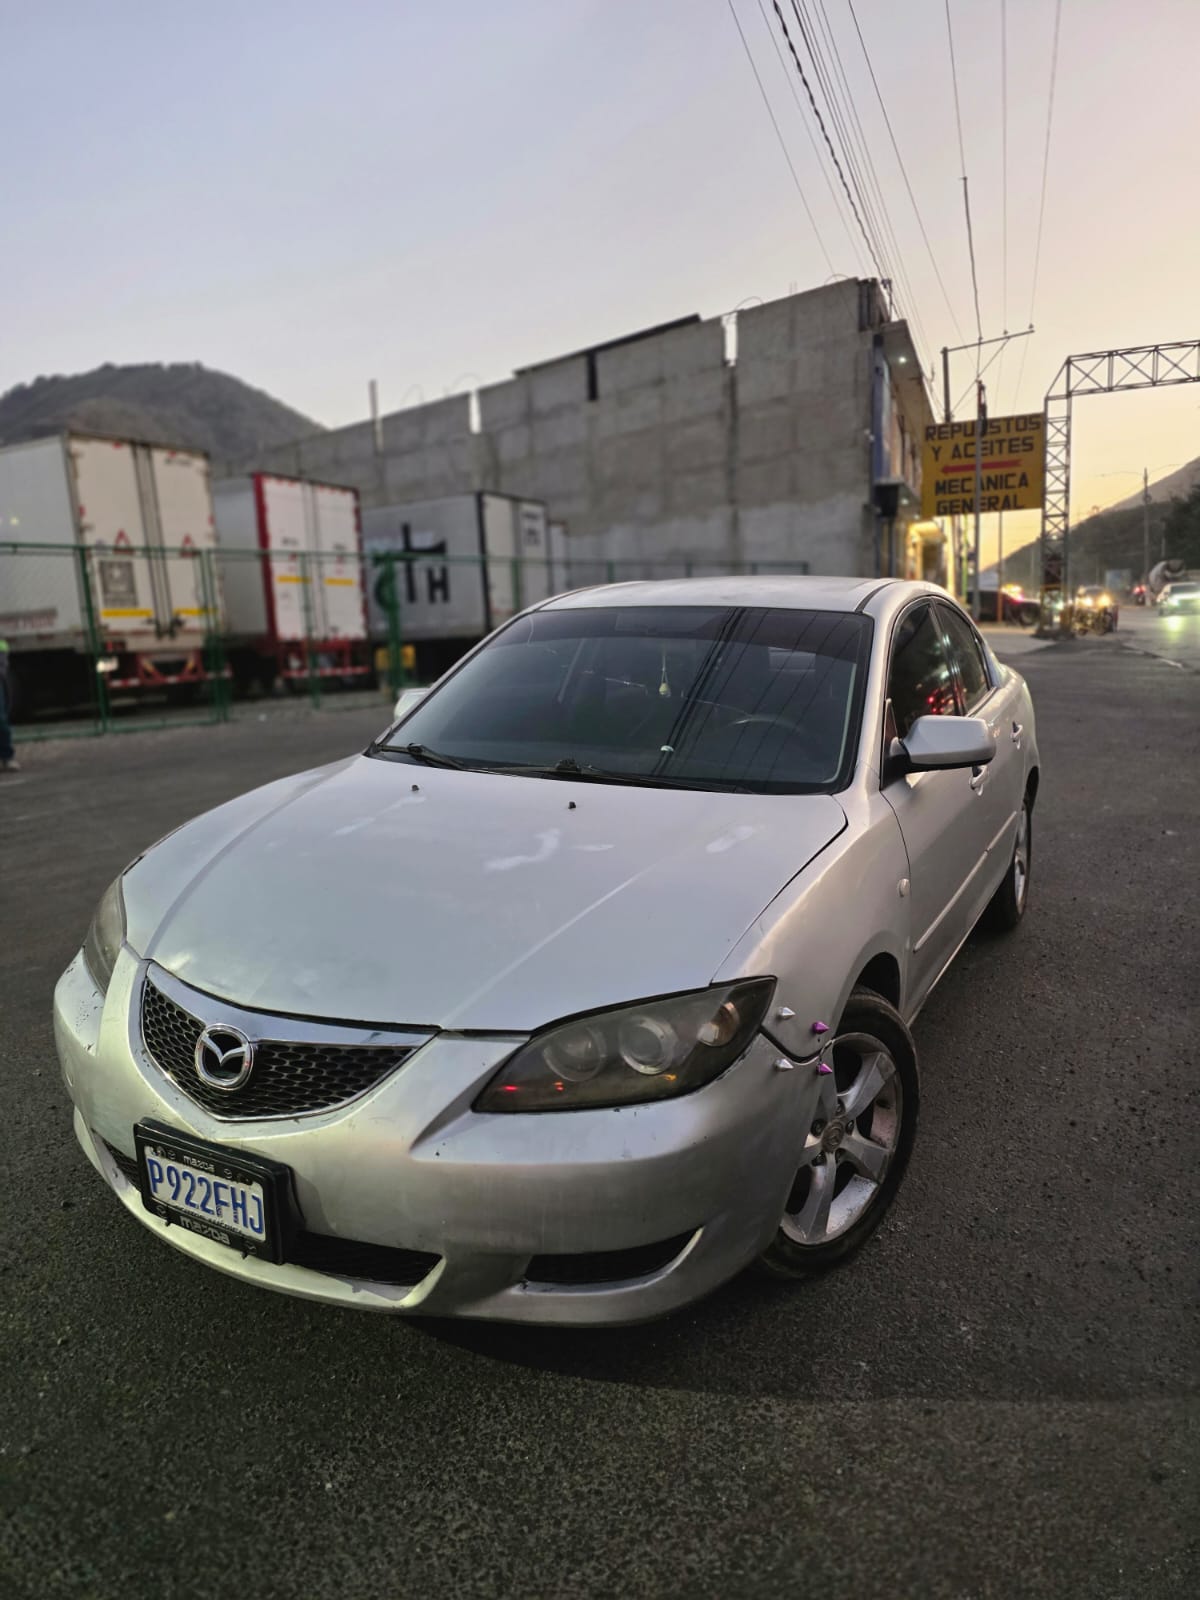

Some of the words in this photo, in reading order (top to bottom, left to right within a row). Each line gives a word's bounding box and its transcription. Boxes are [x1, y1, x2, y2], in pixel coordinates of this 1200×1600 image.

[925, 415, 1041, 441] REPUSTOS
[932, 446, 942, 461] Y
[951, 436, 1034, 460] ACEITES
[147, 1158, 264, 1235] P922FHJ
[180, 1215, 231, 1246] mazda
